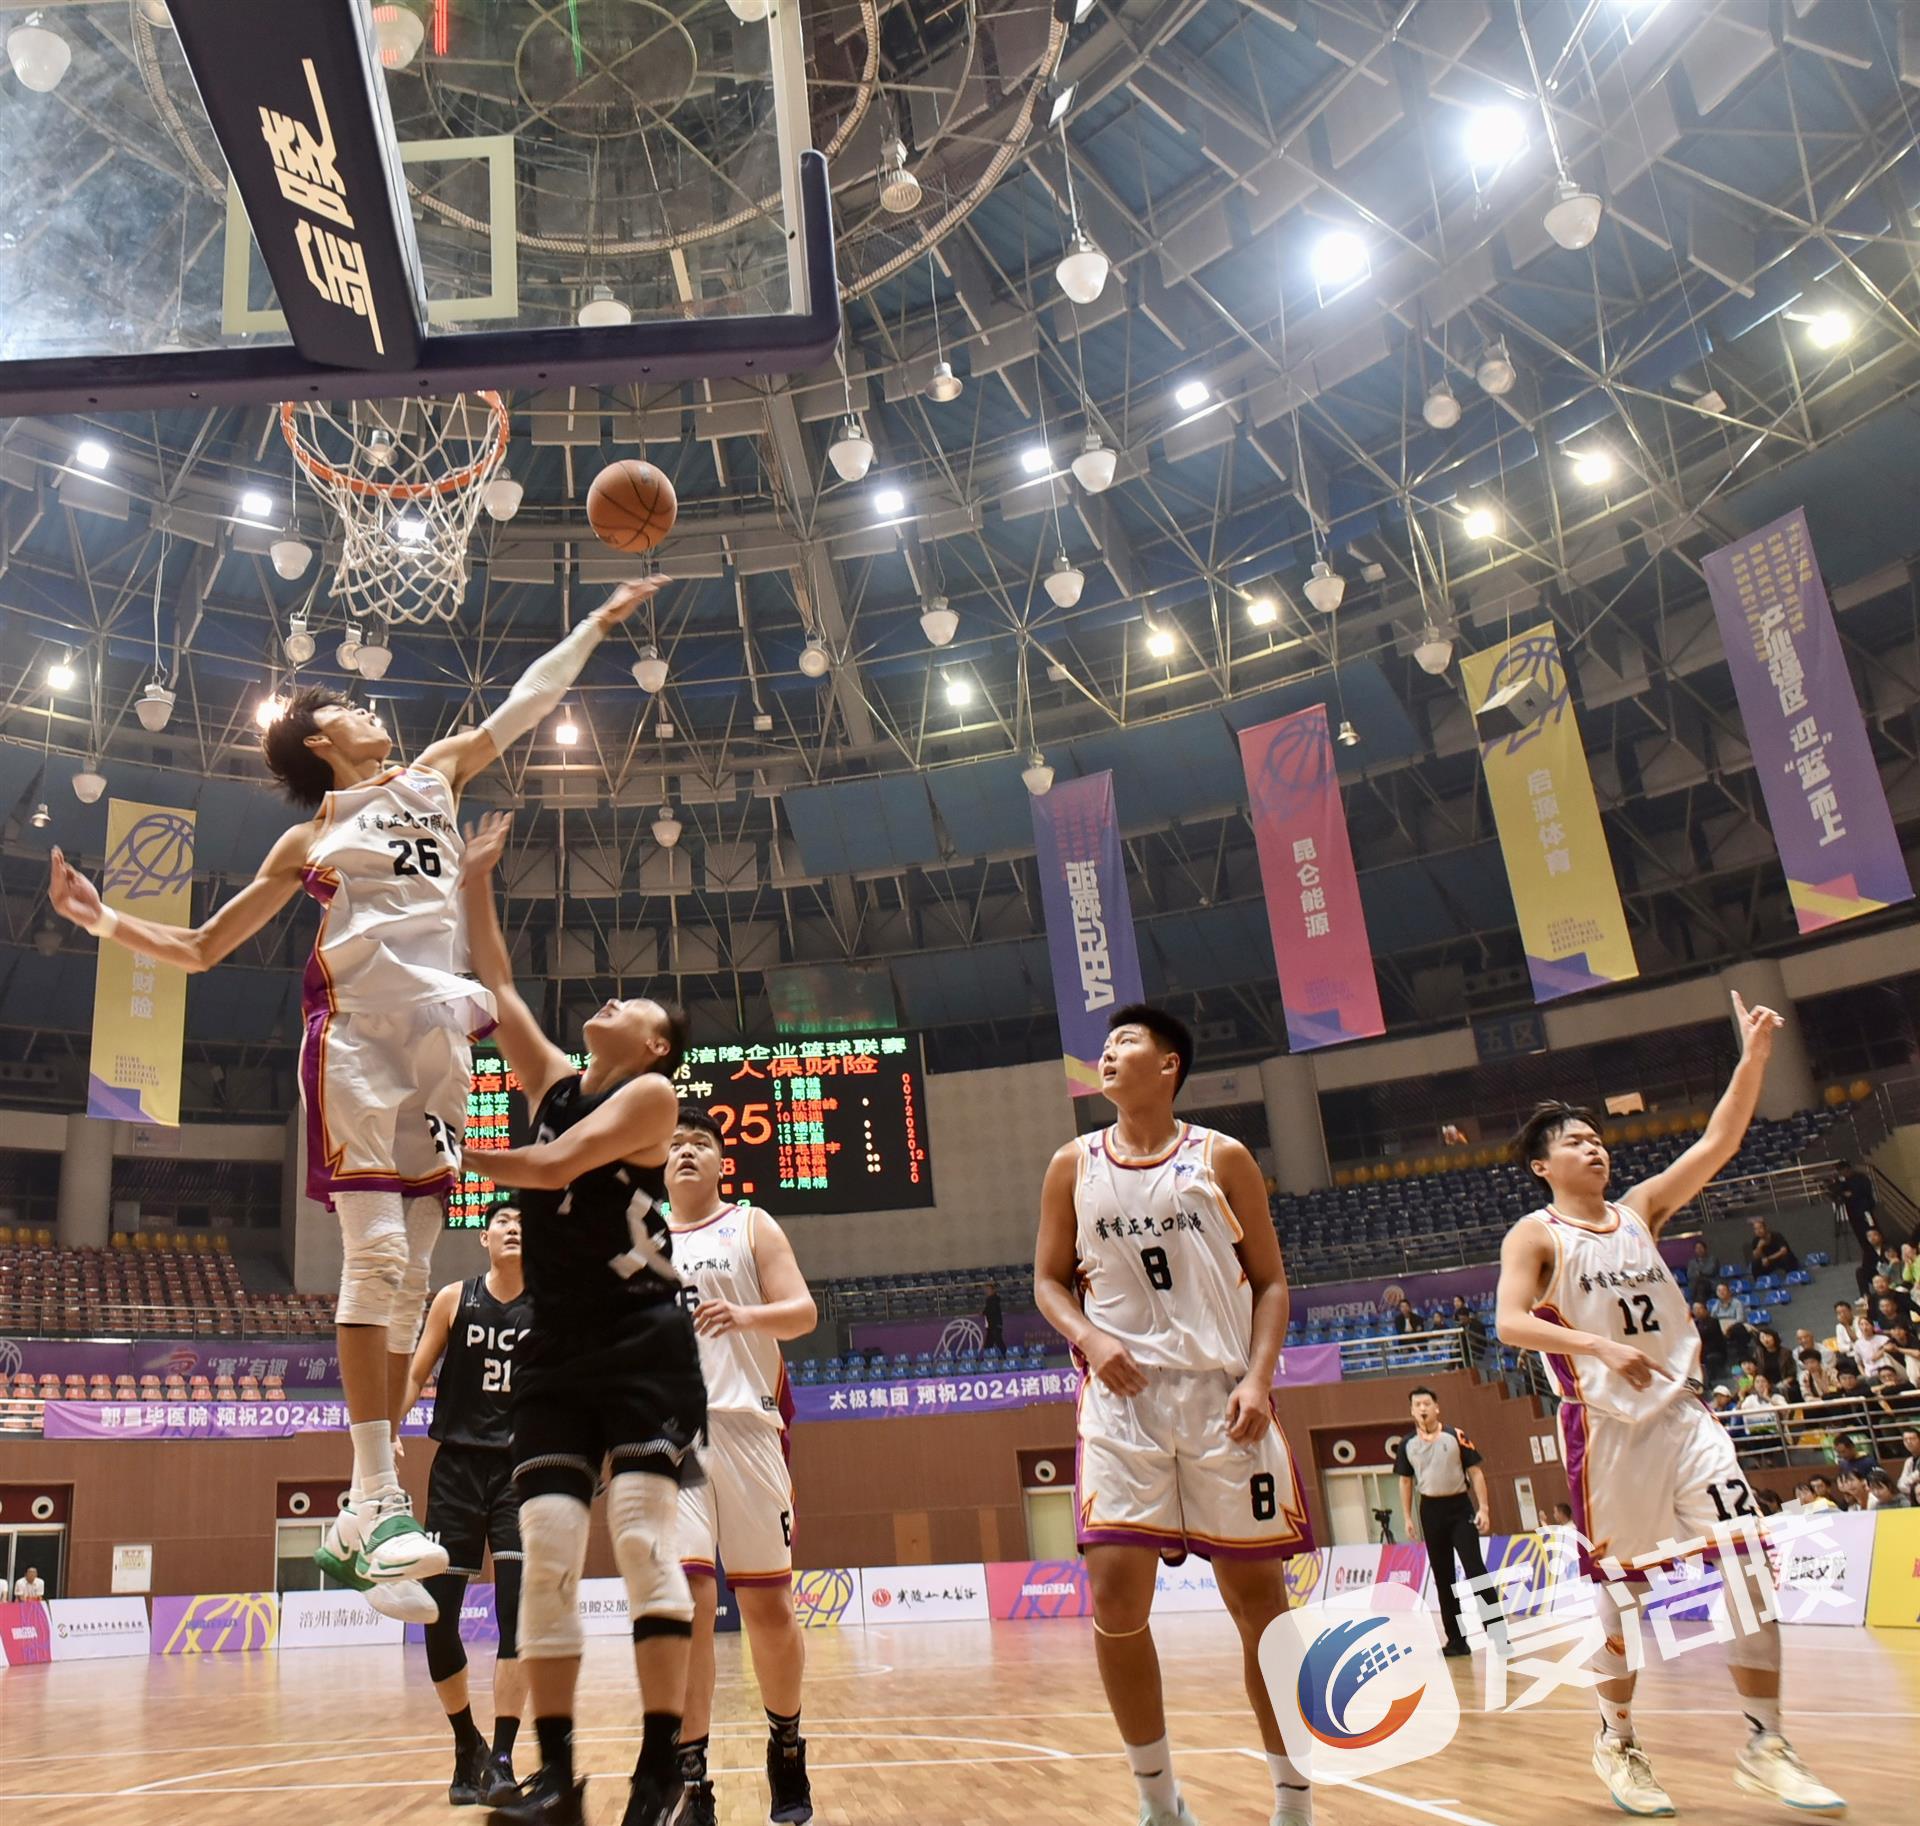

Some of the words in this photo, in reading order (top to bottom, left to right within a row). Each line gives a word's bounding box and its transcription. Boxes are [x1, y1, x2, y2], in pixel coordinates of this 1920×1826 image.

[258, 58, 384, 355] 金陵
[1767, 532, 1806, 634] ENTERPRISE
[388, 838, 442, 877] 26
[1292, 837, 1330, 939] 昆仑能源
[684, 1037, 907, 1064] 涪陵企业篮球联赛
[730, 1053, 879, 1081] 人保财险
[774, 1079, 782, 1090] 0
[902, 1073, 910, 1084] 0
[774, 1090, 782, 1101] 5
[903, 1084, 912, 1095] 0
[776, 1101, 783, 1112] 7
[904, 1095, 912, 1106] 7
[777, 1111, 791, 1122] 10
[905, 1106, 913, 1117] 2
[707, 1103, 773, 1146] 25
[777, 1123, 791, 1134] 12
[906, 1117, 914, 1128] 0
[778, 1133, 791, 1144] 13
[906, 1128, 915, 1139] 2
[907, 1139, 916, 1150] 0
[779, 1156, 792, 1167] 21
[909, 1149, 925, 1160] 12
[780, 1167, 794, 1178] 22
[910, 1161, 919, 1172] 2
[780, 1178, 795, 1189] 44
[911, 1172, 919, 1184] 0
[449, 1194, 463, 1205] 15
[448, 1206, 463, 1217] 26
[448, 1216, 463, 1228] 27
[1140, 1245, 1173, 1291] 8
[1618, 1294, 1661, 1335] 12
[482, 1357, 512, 1393] 21
[829, 1383, 909, 1411] 太极集团
[1250, 1472, 1276, 1521] 8
[1706, 1478, 1758, 1521] 12
